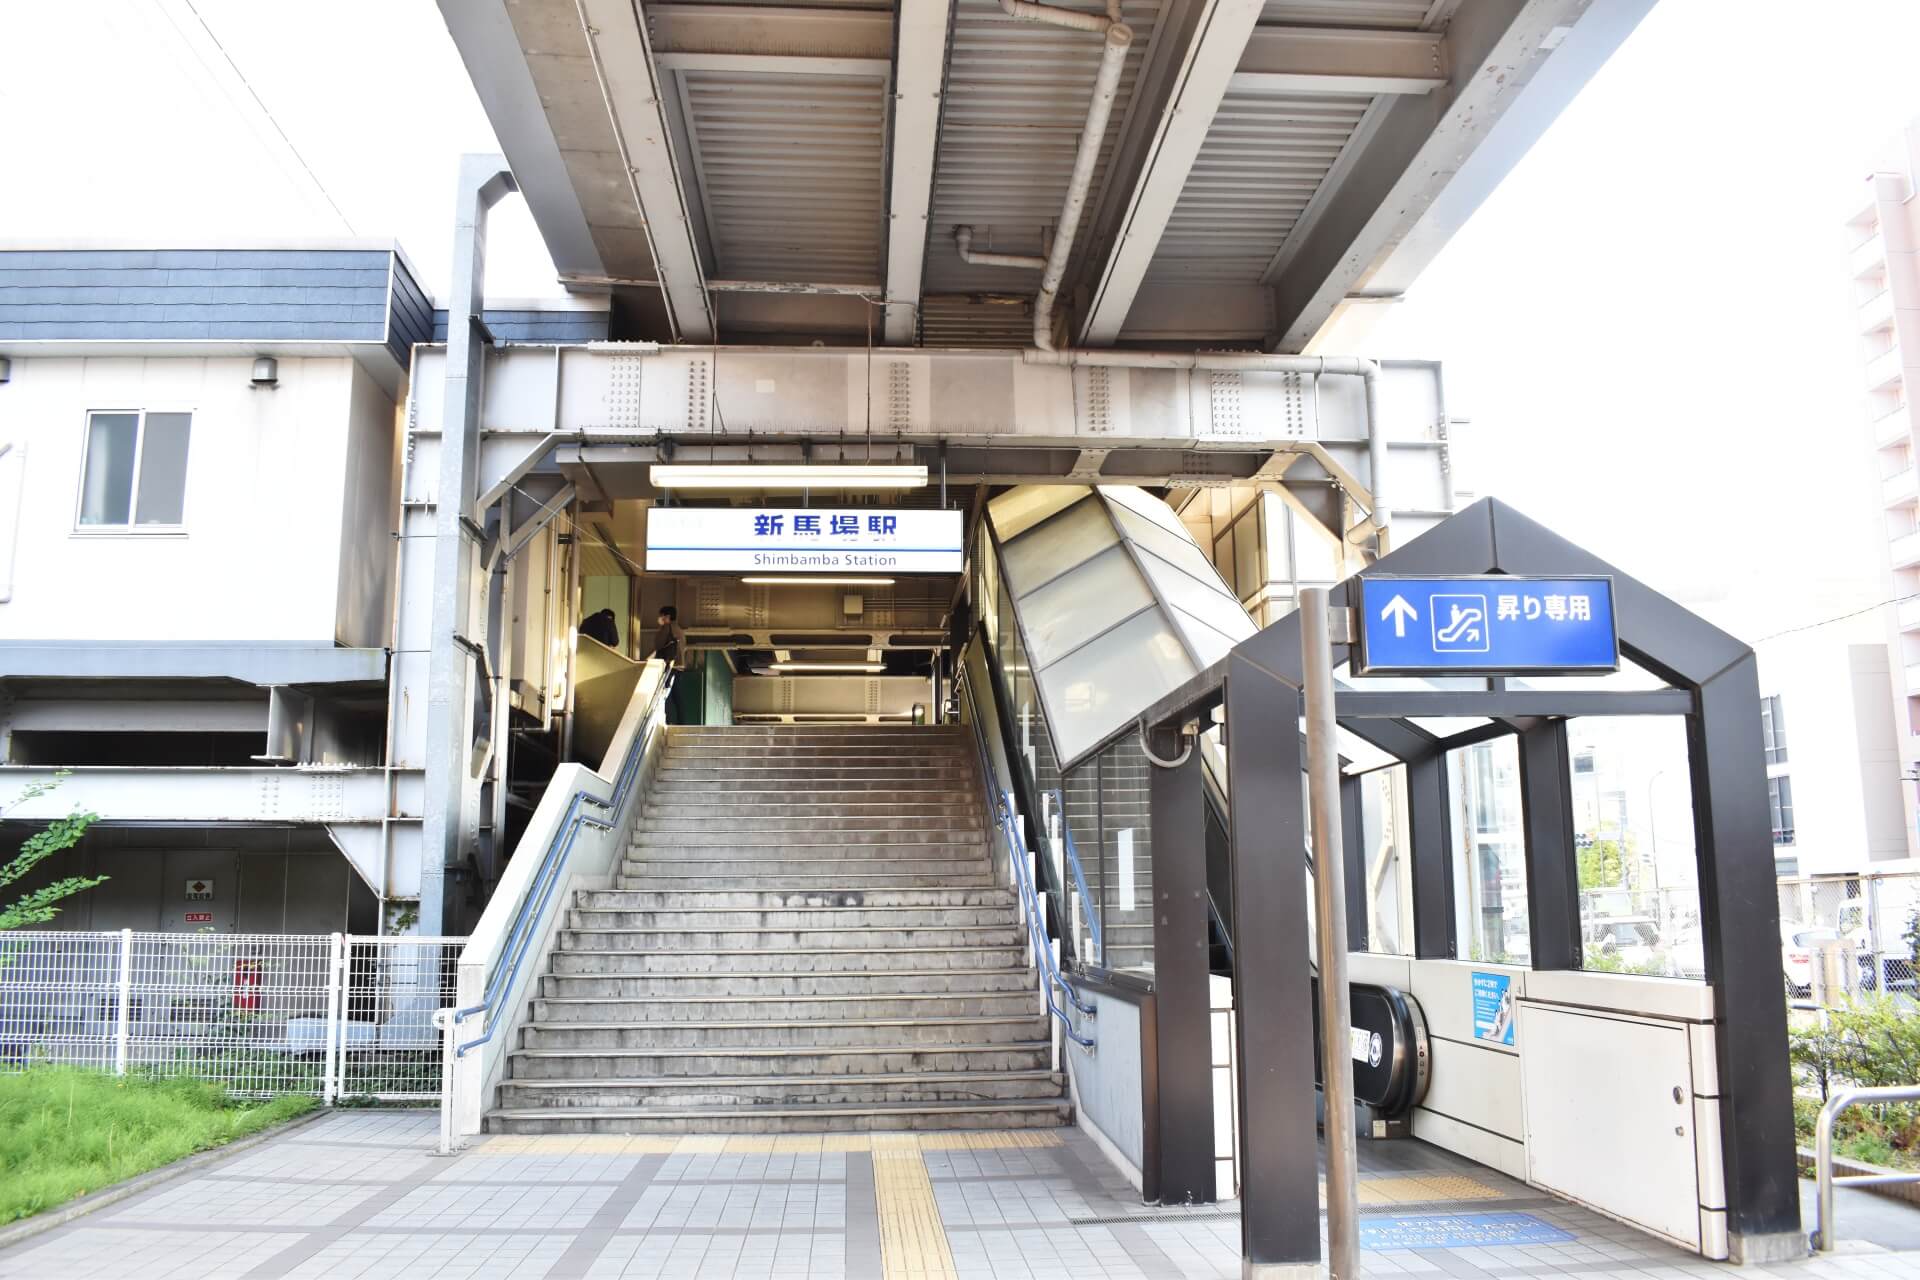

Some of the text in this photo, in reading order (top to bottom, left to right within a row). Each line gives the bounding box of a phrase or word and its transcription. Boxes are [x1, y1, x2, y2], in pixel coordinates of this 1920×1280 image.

[754, 514, 897, 539] 新馬場駅
[754, 553, 897, 567] Shimbamba Station
[1497, 595, 1591, 621] 昇り専用
